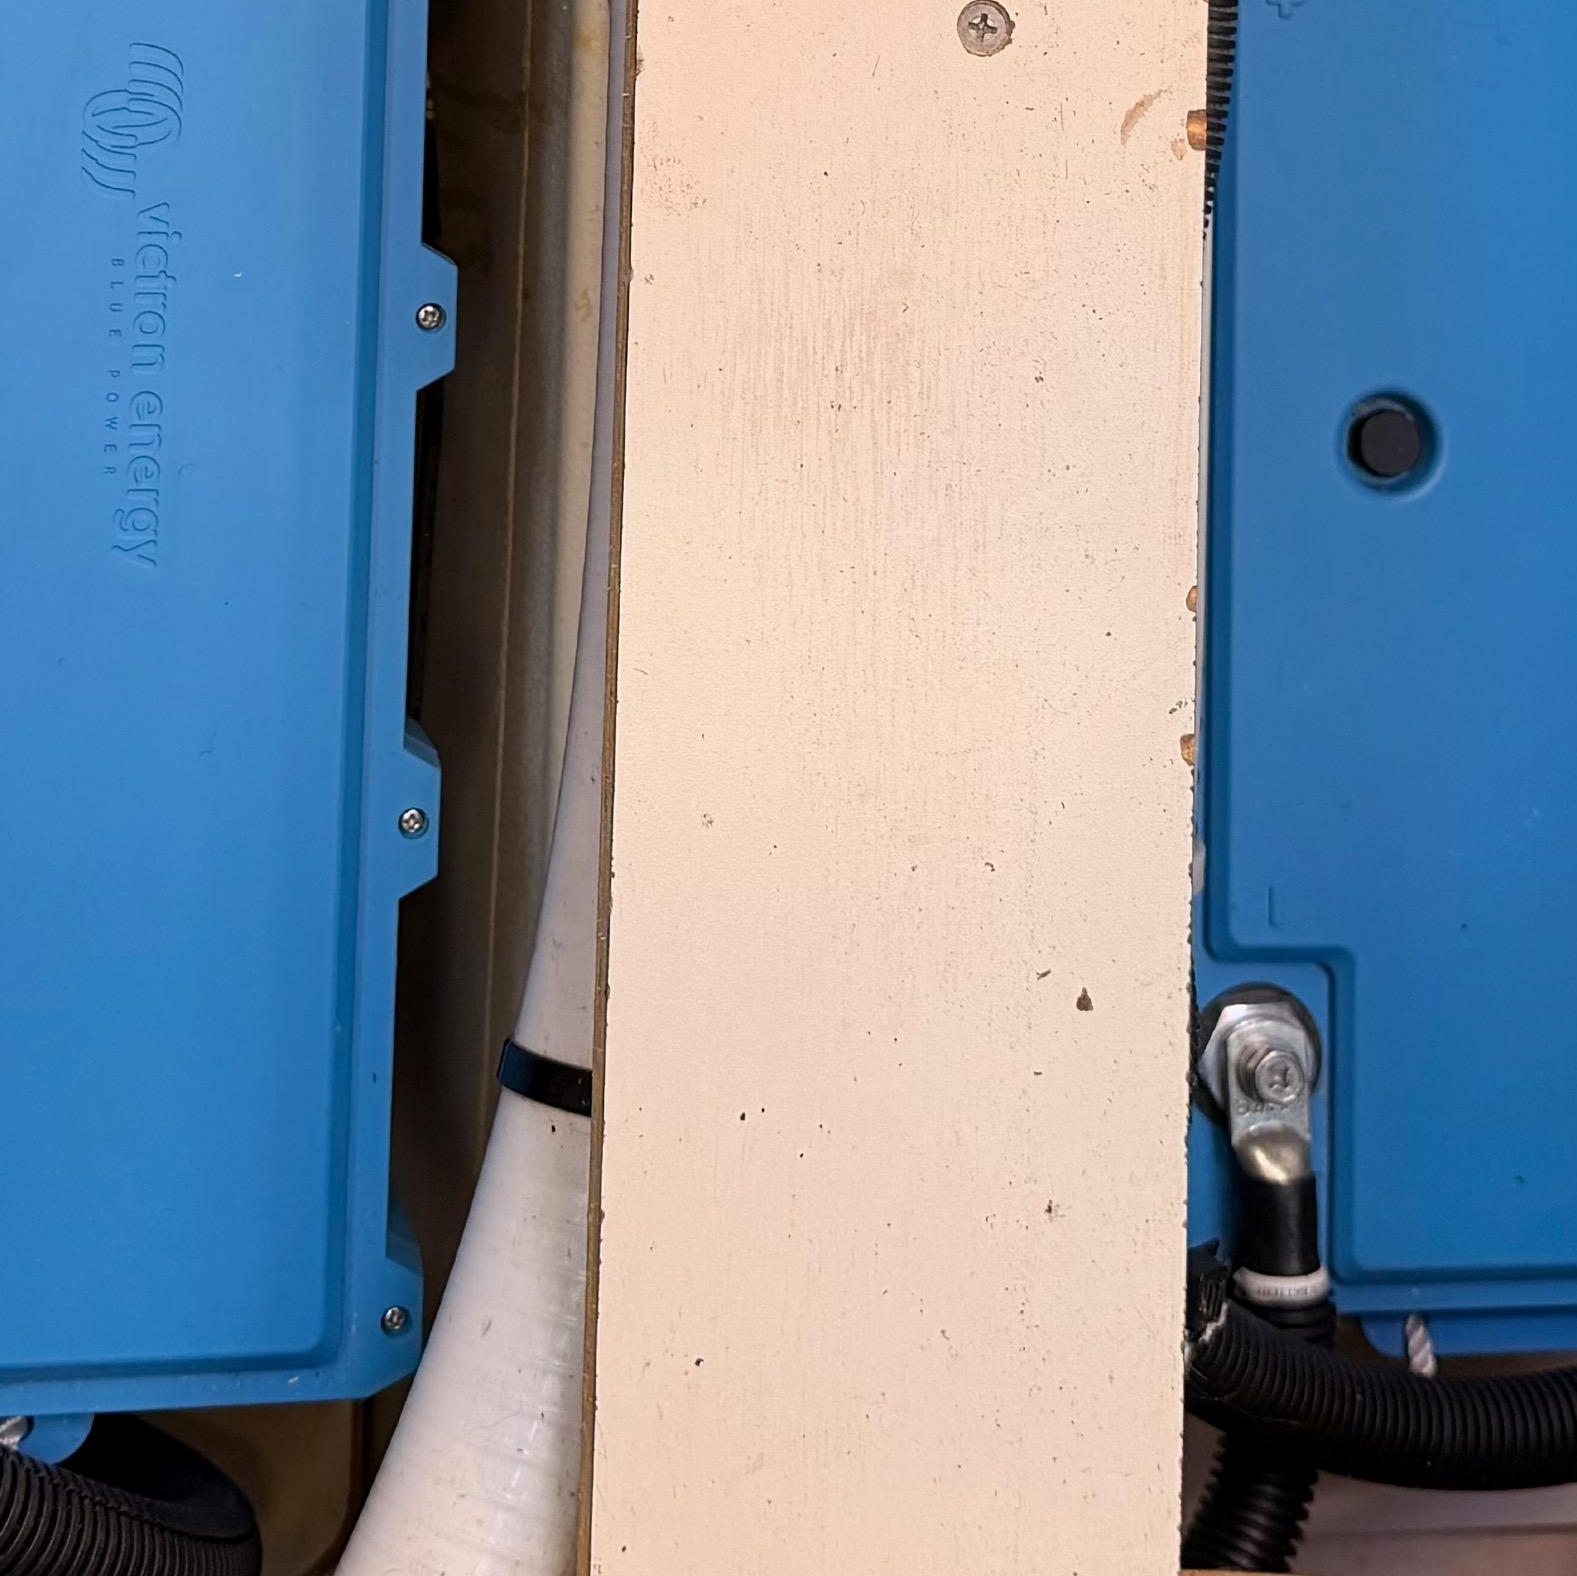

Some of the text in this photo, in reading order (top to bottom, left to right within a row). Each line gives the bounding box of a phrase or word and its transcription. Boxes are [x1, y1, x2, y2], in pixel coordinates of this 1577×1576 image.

[108, 256, 125, 338] BLUE
[133, 201, 184, 375] victron
[102, 369, 121, 476] POWER
[111, 388, 165, 570] energy
